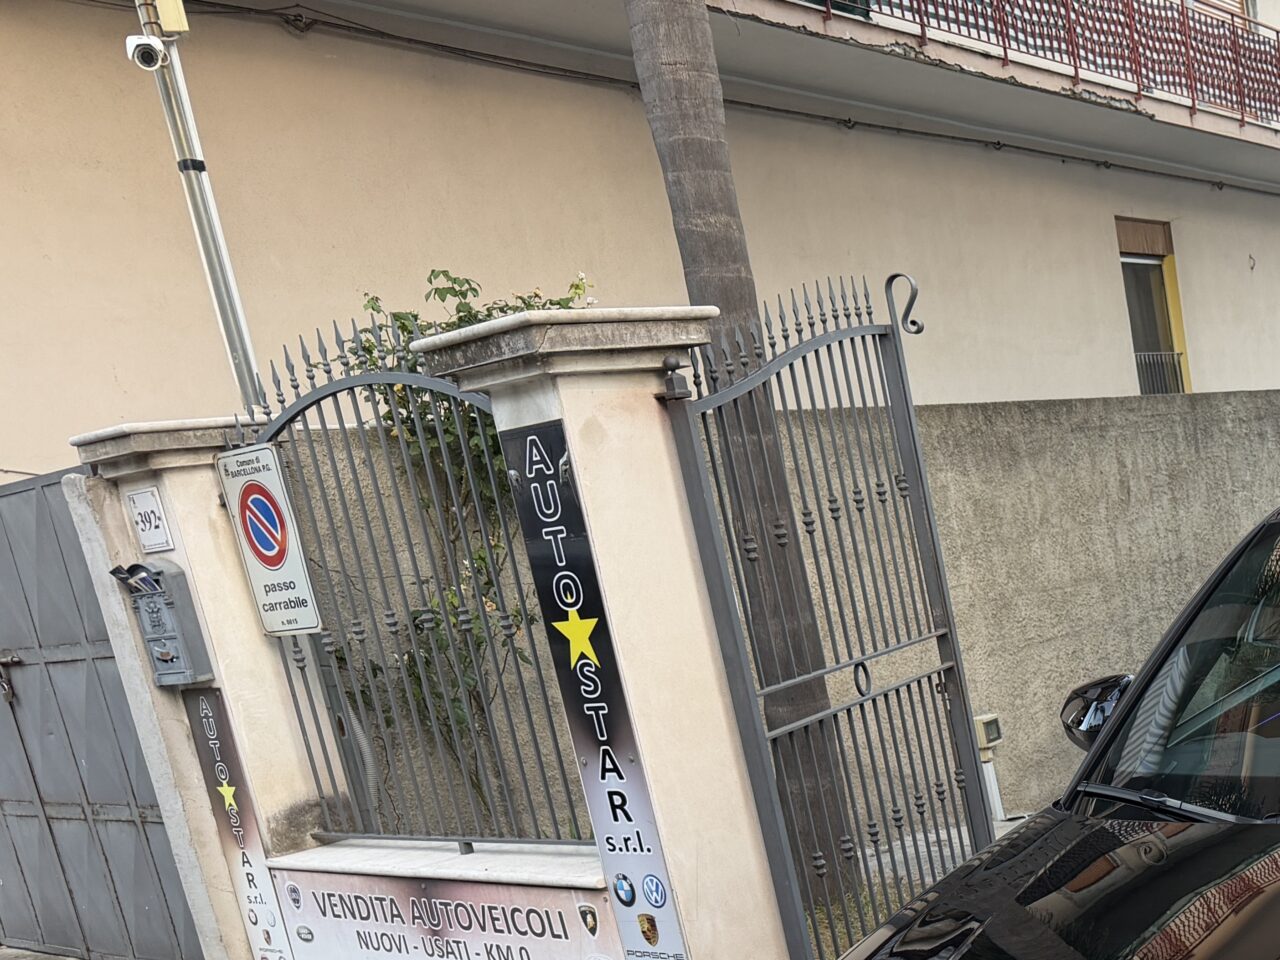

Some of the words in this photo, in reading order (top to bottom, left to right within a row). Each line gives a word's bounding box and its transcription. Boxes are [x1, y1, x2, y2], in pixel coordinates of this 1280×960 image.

[230, 465, 262, 478] BARCELLONA
[236, 458, 255, 467] Comune
[138, 510, 160, 532] 392
[264, 580, 296, 596] passo
[262, 596, 308, 612] carrabile
[525, 435, 583, 611] AUTO
[576, 659, 633, 824] STAR
[605, 831, 652, 853] s.r.l.
[200, 697, 230, 782] AUTO
[229, 807, 258, 889] STAR
[312, 891, 406, 925] VENDITA
[411, 897, 569, 940] AUTOVEICOLI
[356, 930, 409, 954] NUOVI
[421, 936, 471, 960] USATI
[627, 950, 684, 960] PORSCHE
